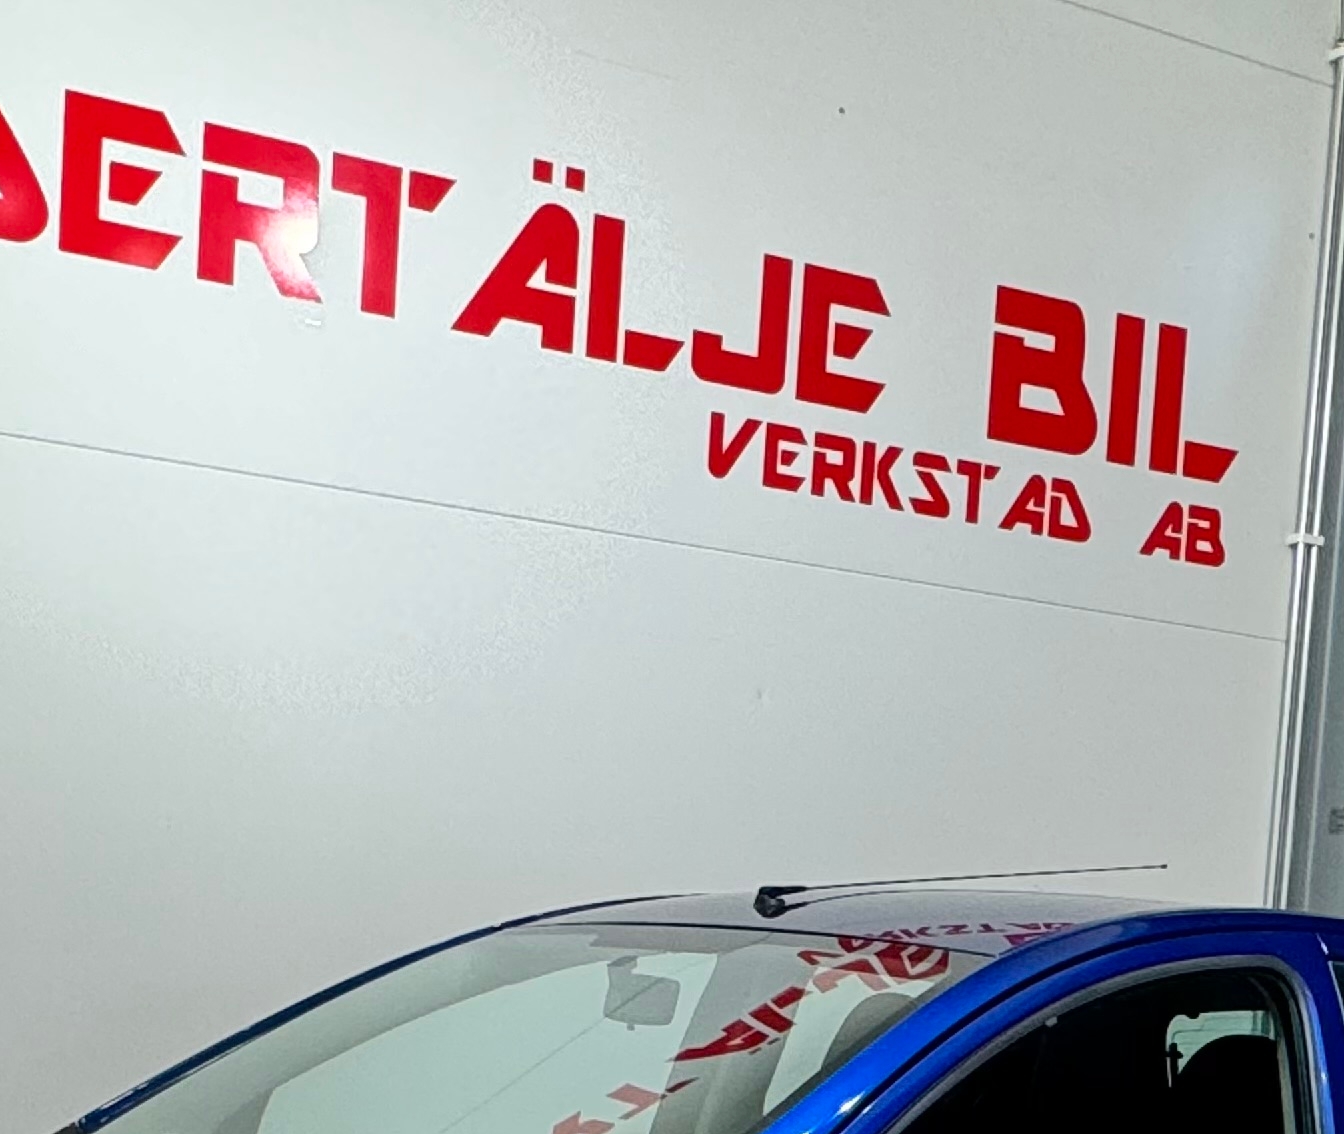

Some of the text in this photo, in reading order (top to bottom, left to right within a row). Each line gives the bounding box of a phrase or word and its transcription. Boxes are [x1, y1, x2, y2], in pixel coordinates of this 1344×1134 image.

[987, 285, 1240, 483] BIL
[707, 412, 1227, 568] VERKSTAD AB
